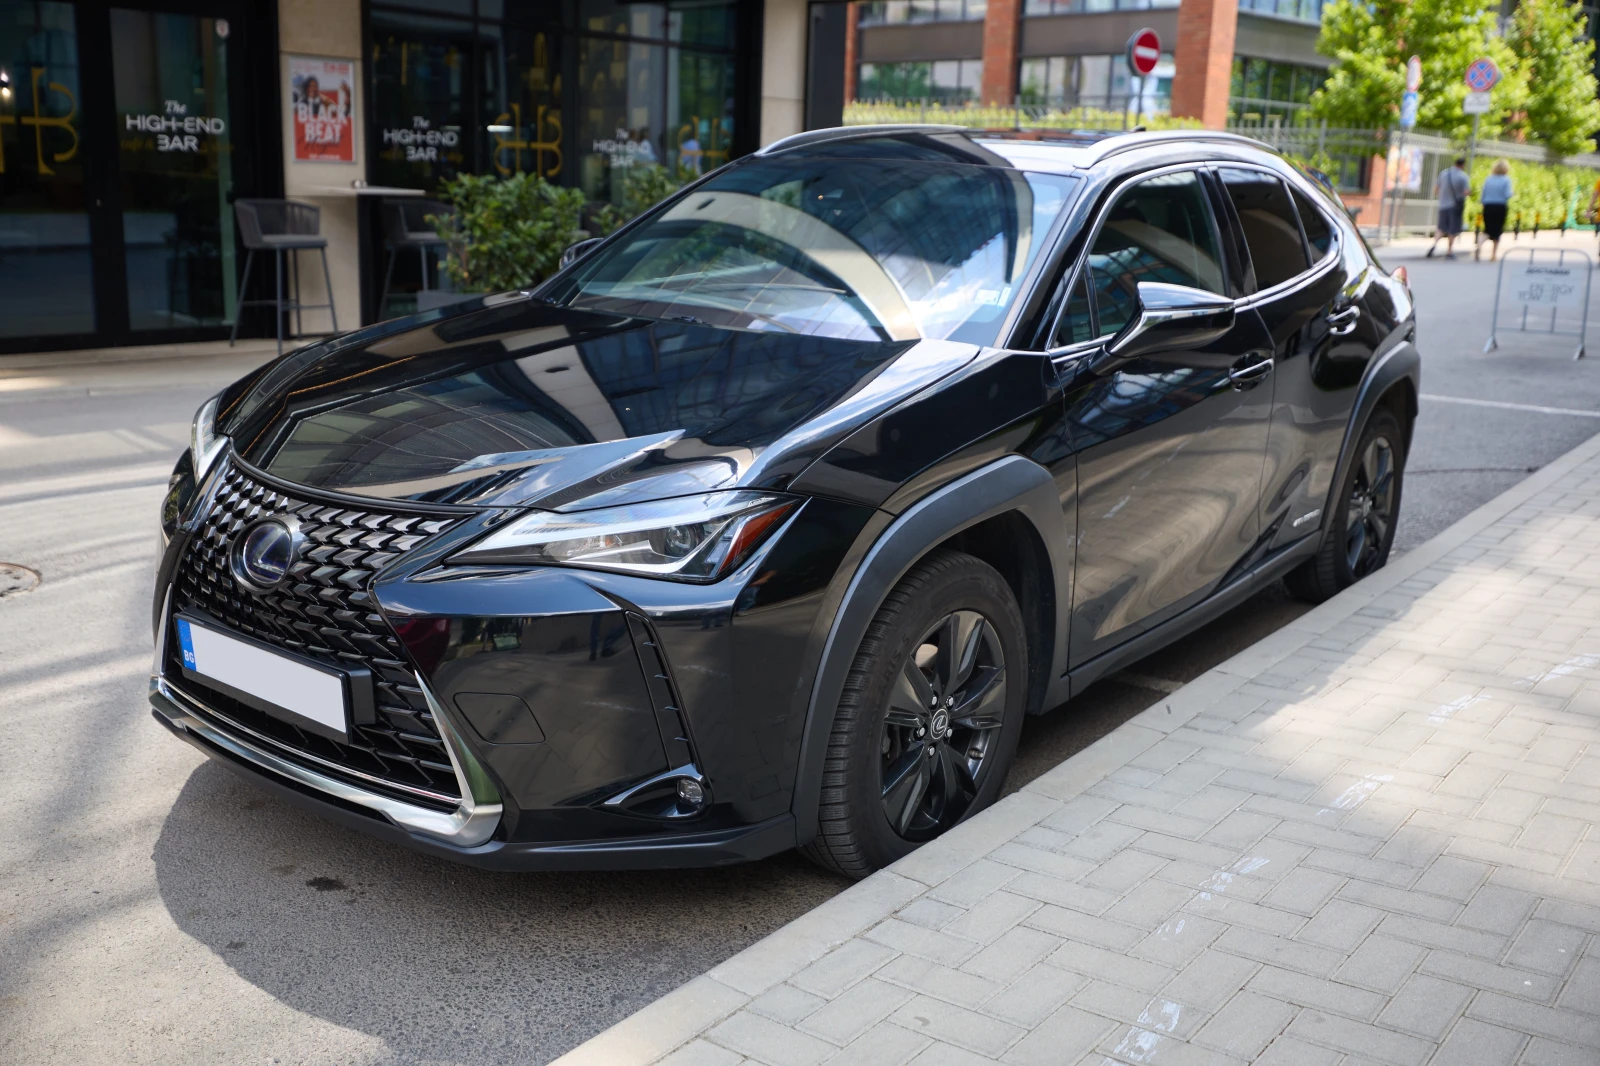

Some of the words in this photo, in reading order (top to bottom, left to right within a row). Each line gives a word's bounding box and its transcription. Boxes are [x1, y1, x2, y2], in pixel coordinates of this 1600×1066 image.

[165, 100, 187, 114] The
[297, 102, 348, 125] BLACK
[125, 114, 225, 135] HIGH-END
[412, 116, 430, 129] The
[305, 122, 342, 144] BEAT
[383, 128, 458, 147] HIGH-END
[156, 134, 200, 153] BAR
[183, 649, 195, 664] BG
